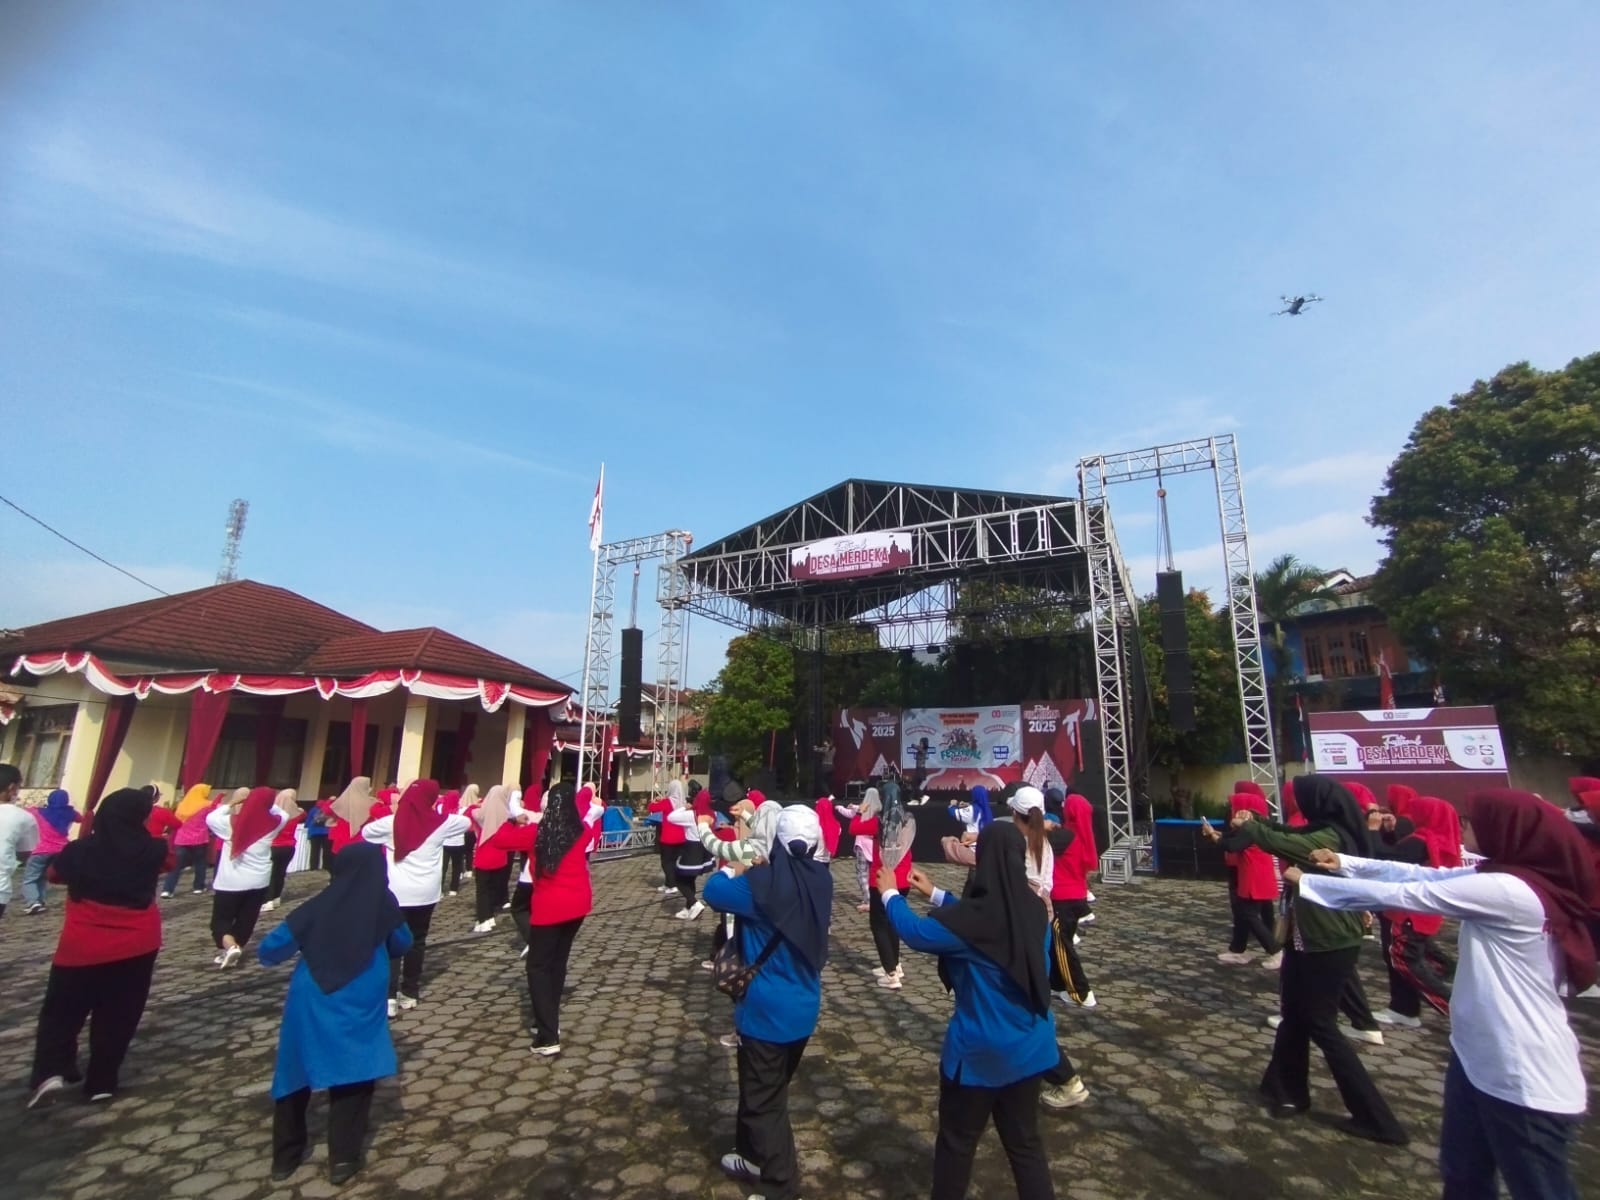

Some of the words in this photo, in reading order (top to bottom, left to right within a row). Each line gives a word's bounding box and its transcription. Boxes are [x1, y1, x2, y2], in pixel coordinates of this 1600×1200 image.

[810, 554, 836, 573] DESA
[839, 547, 889, 565] MERDEKA
[872, 725, 895, 737] 2025
[1028, 720, 1056, 733] 2025
[1357, 746, 1389, 761] DESA
[1391, 745, 1452, 760] MERDEKA
